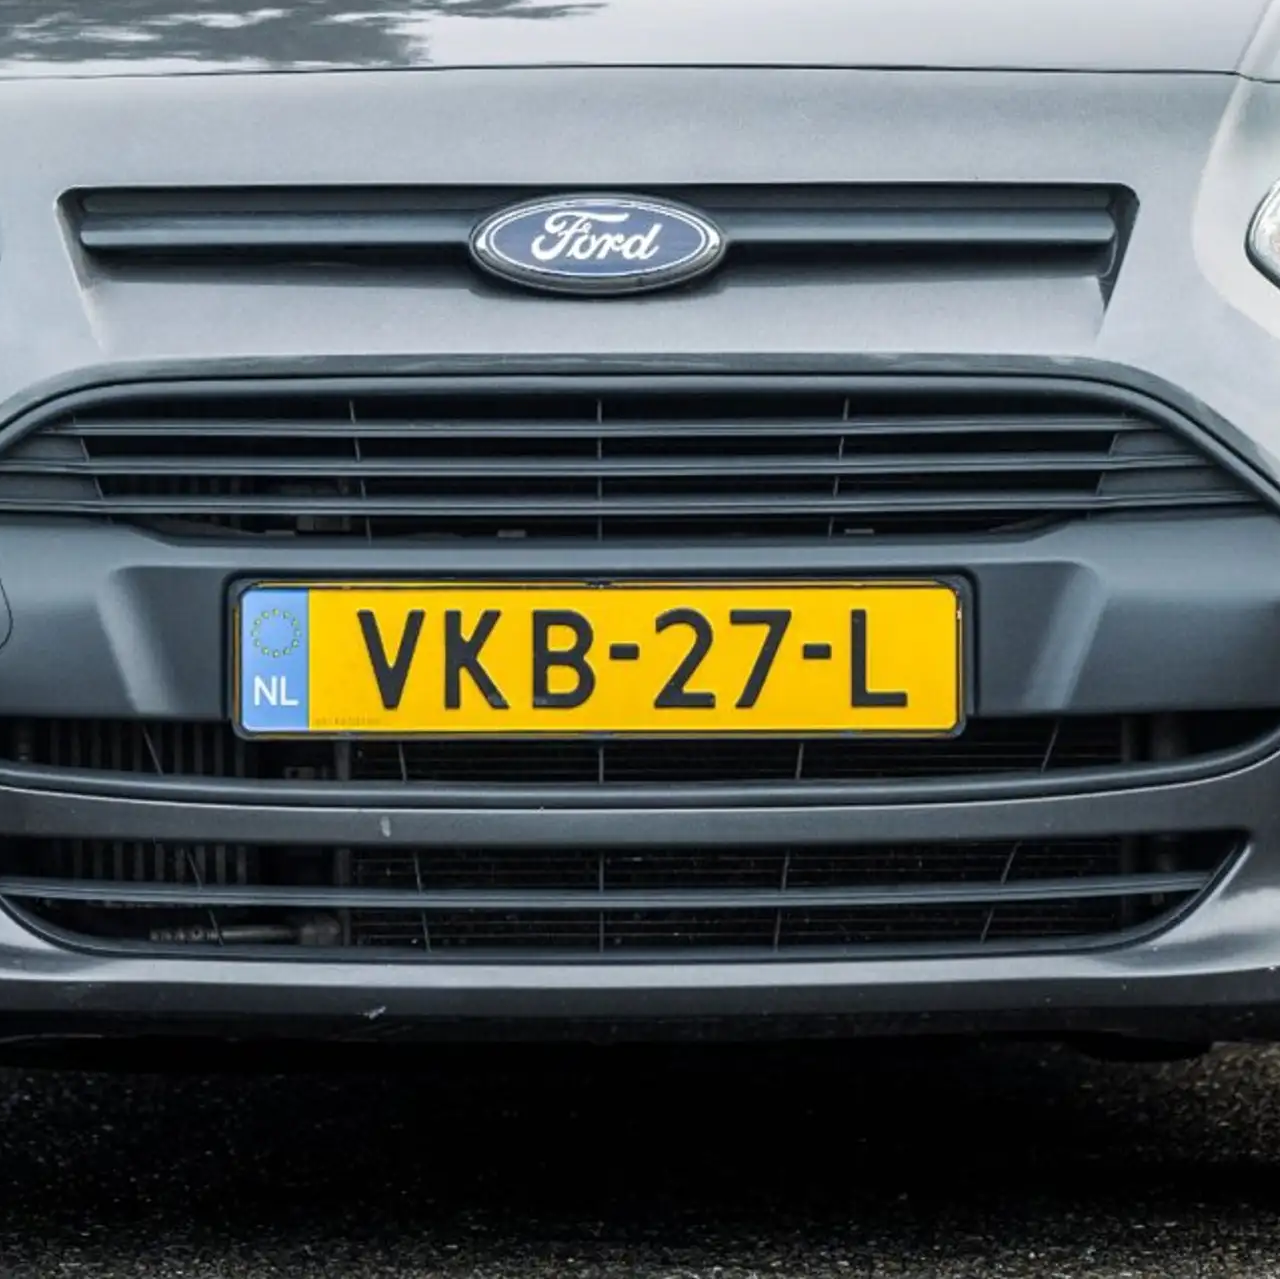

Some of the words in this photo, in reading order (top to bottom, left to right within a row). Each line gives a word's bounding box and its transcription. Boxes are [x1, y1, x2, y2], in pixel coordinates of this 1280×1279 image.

[531, 211, 662, 261] Ford
[356, 608, 909, 711] VKB-27-L
[253, 675, 300, 707] NL
